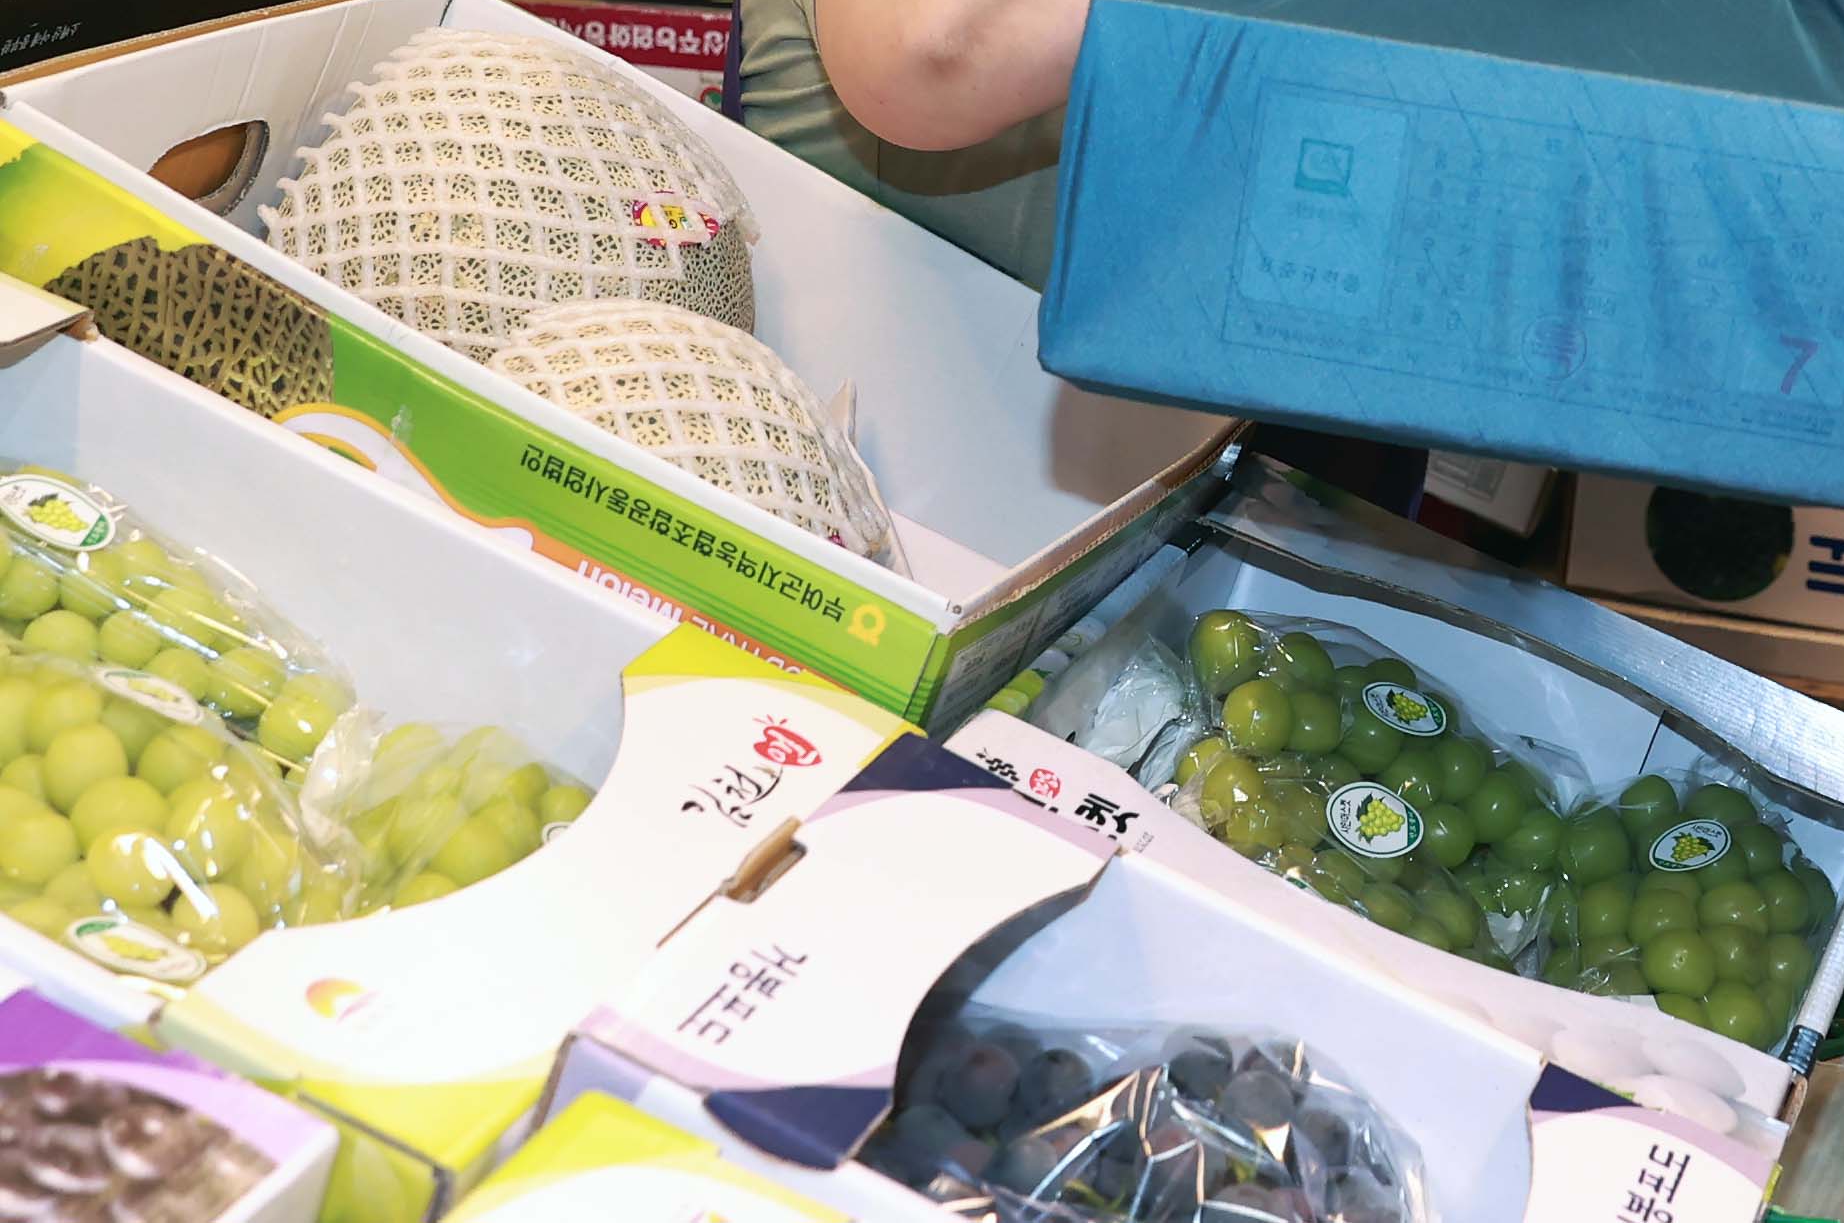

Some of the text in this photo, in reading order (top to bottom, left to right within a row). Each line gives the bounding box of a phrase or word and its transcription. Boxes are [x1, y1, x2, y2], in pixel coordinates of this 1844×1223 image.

[520, 443, 846, 623] 부여군지역농협조합공동사업법인
[677, 942, 809, 1045] 거봉포도
[1616, 1143, 1691, 1223] 봉포도
